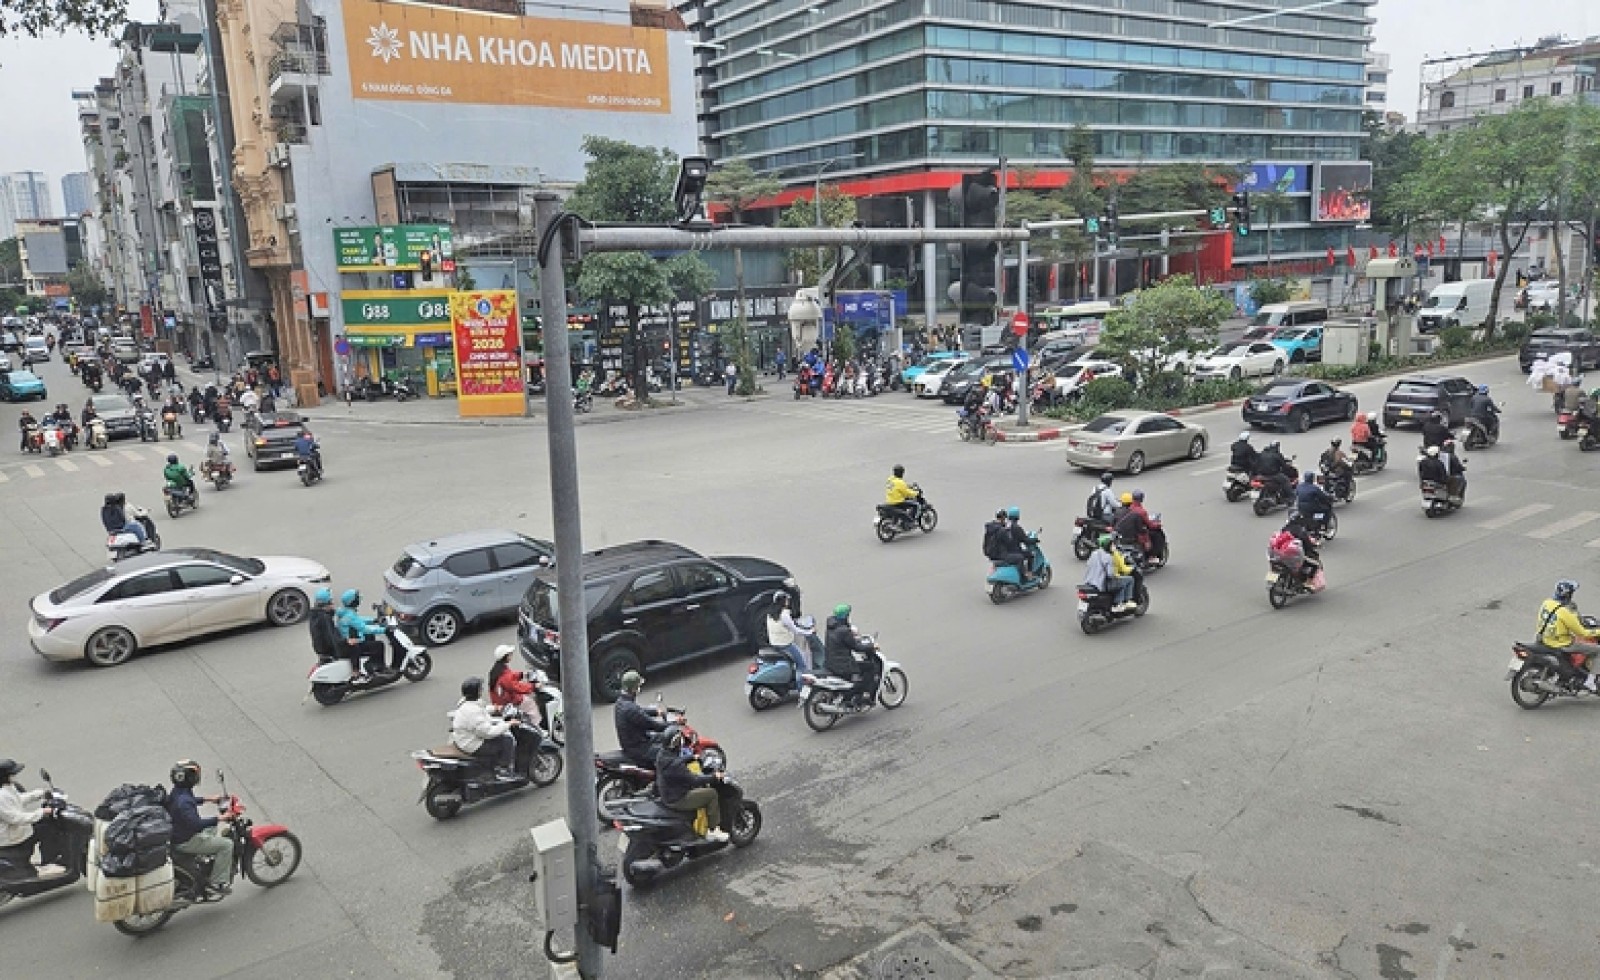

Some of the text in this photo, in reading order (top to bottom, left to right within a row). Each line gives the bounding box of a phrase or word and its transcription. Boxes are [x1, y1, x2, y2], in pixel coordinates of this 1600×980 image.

[408, 30, 652, 75] NHA KHOA MEDITA
[362, 303, 390, 319] F88
